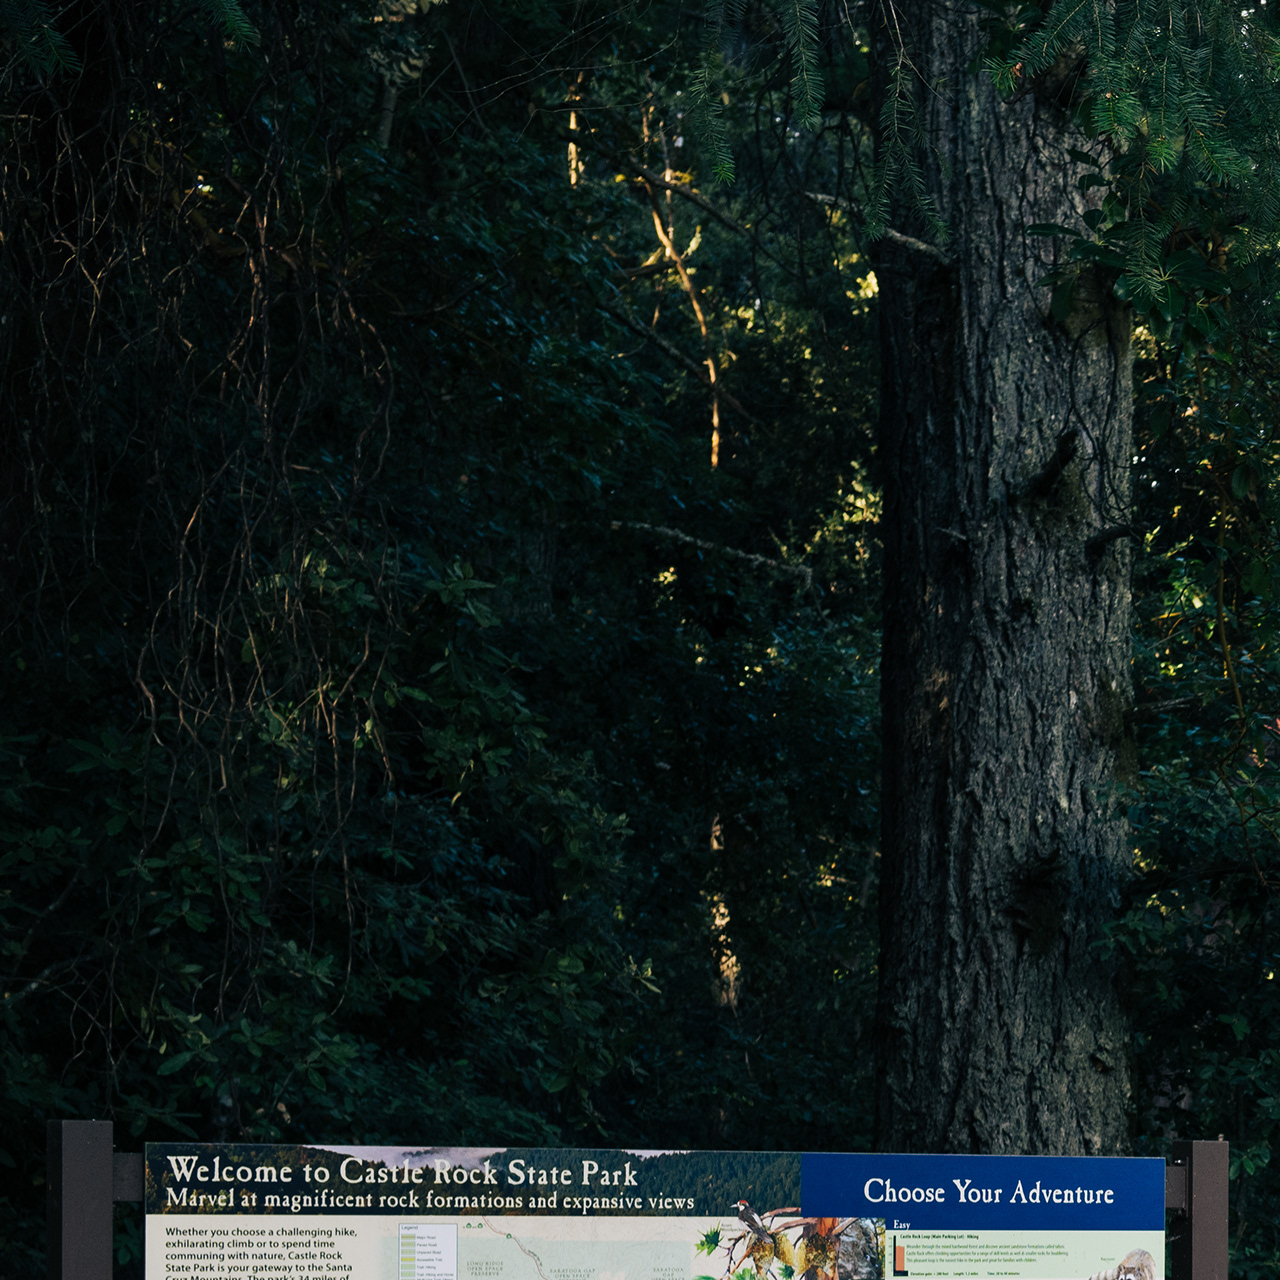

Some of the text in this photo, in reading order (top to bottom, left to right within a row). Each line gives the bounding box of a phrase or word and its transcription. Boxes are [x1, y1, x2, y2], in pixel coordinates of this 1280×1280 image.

[166, 1155, 638, 1186] Welcome to Castle Rock State Park
[863, 1177, 1114, 1204] Choose Your Adventure
[166, 1187, 695, 1214] Marvel at magnificent rock formations and expansive views
[893, 1219, 911, 1232] Easy
[165, 1227, 208, 1237] Whether
[210, 1229, 229, 1239] you
[231, 1227, 266, 1237] choose
[276, 1227, 333, 1239] challenging
[334, 1227, 358, 1237] hike,
[165, 1239, 225, 1251] exhilarating
[226, 1239, 255, 1248] climb
[269, 1240, 280, 1248] to
[281, 1239, 311, 1250] spend
[313, 1239, 335, 1248] time
[165, 1251, 343, 1263] communing with nature, Castle Rock
